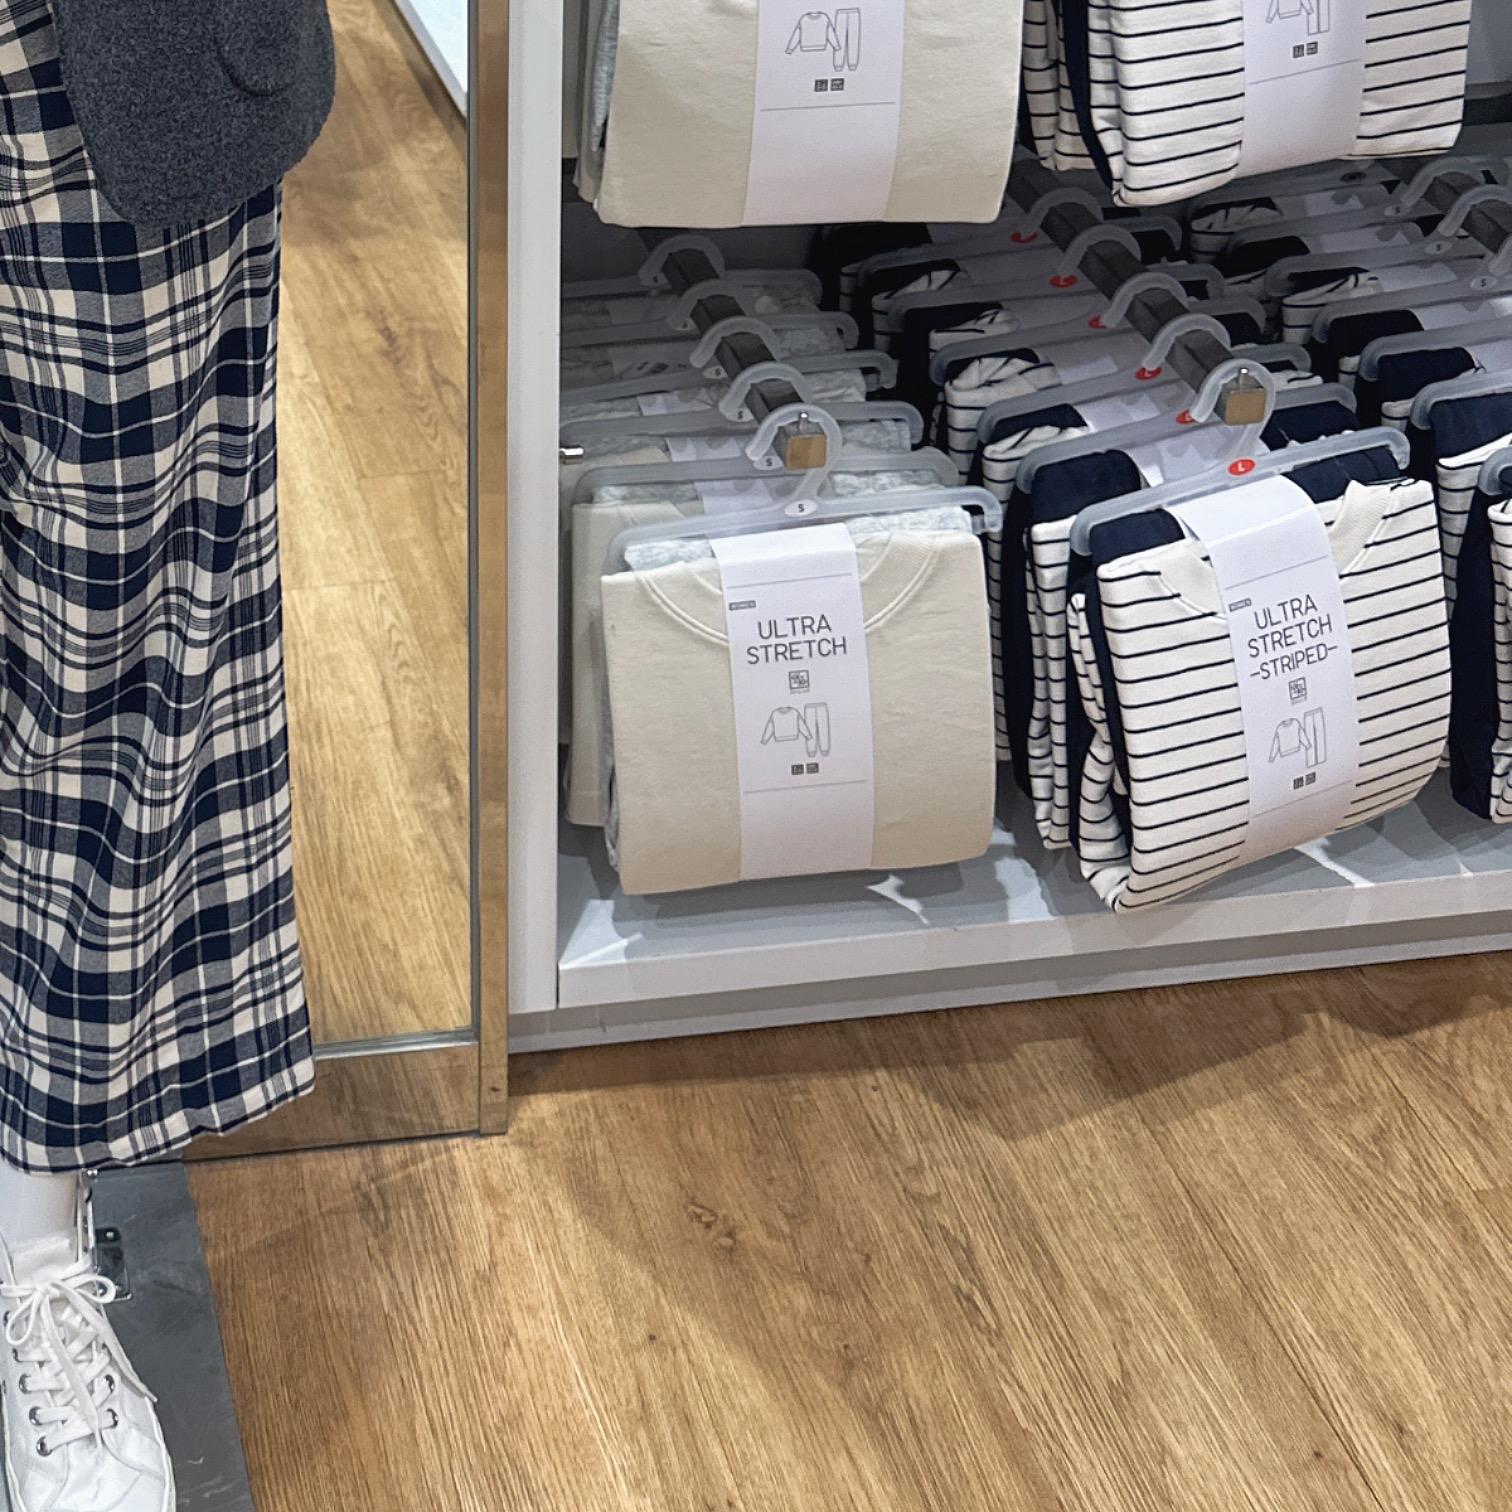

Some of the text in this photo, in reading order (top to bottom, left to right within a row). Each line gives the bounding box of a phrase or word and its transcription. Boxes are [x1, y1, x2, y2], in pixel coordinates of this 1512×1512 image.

[798, 503, 805, 513] S
[1253, 594, 1318, 630] ULTRA
[757, 614, 832, 640] ULTRA
[1248, 614, 1333, 659] STRETCH
[746, 636, 847, 665] STRETCH
